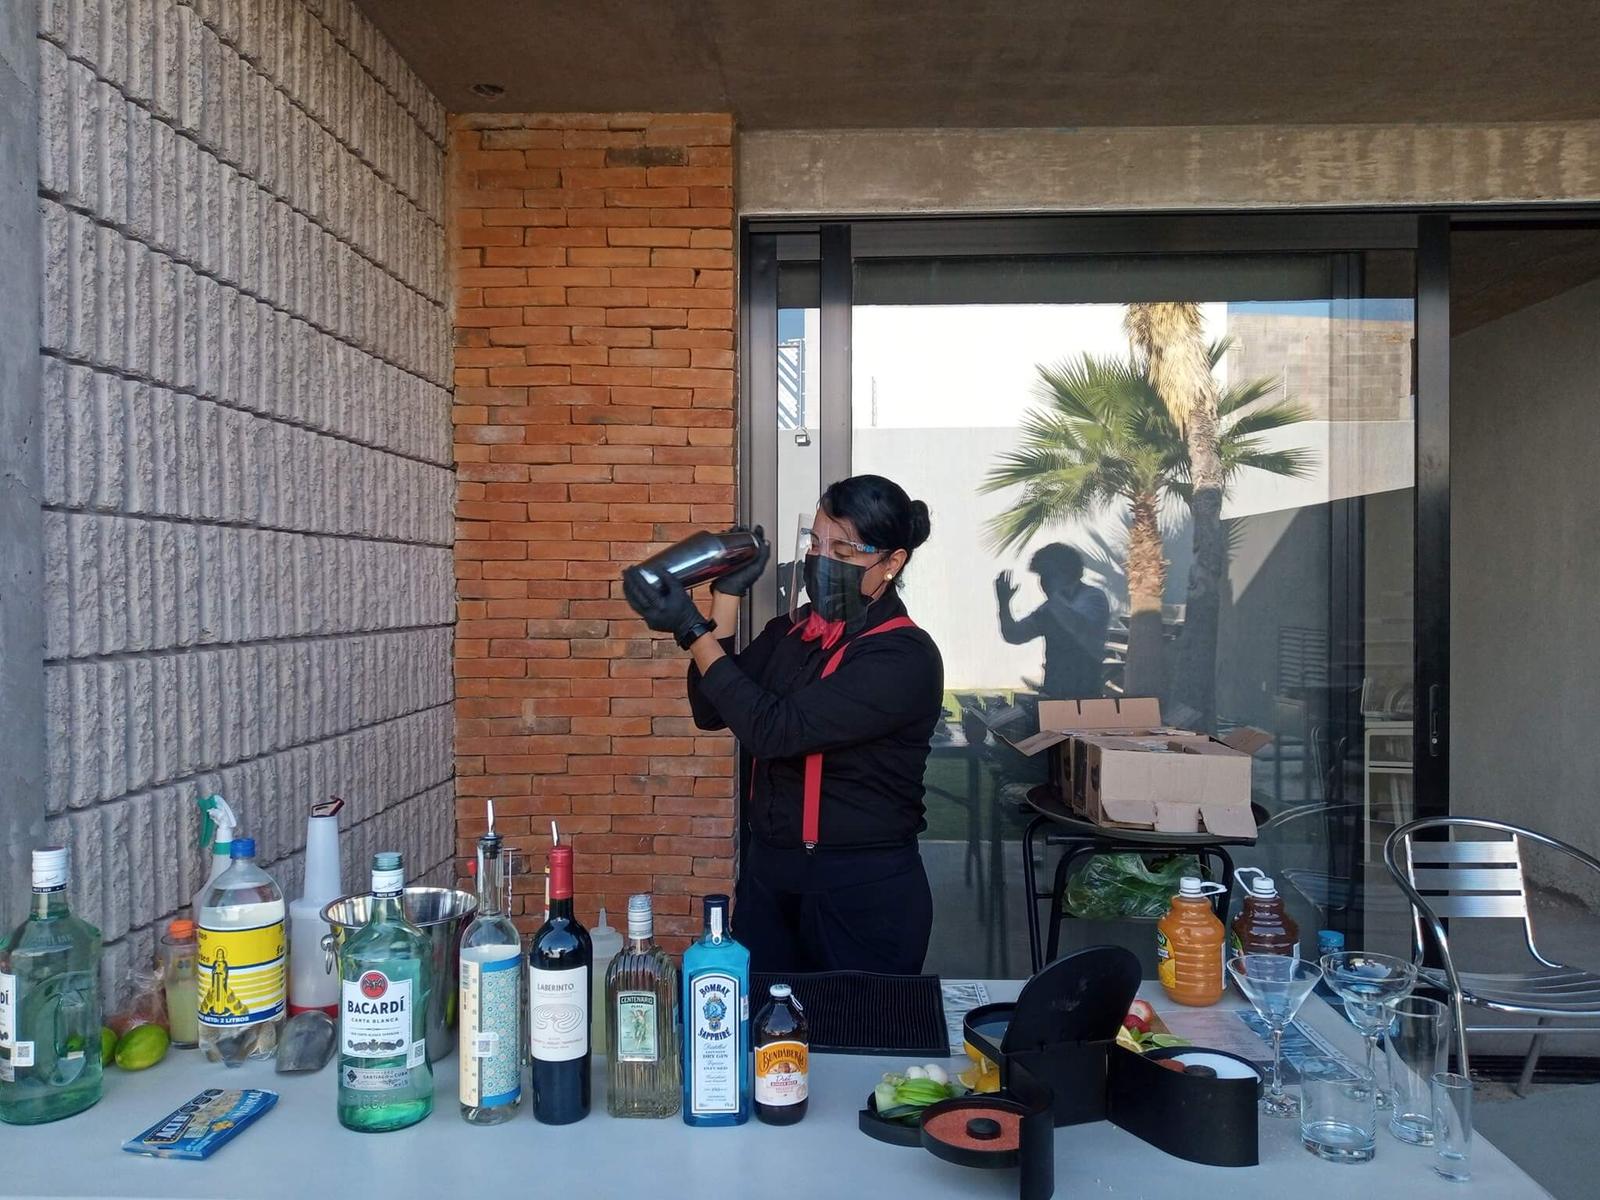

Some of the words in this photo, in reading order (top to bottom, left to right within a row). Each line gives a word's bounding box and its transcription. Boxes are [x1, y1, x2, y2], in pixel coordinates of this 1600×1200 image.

[537, 983, 574, 992] LABERINTO
[699, 983, 731, 998] BOMBAY
[347, 995, 405, 1015] BACARDÍ
[225, 1015, 250, 1024] LITROS
[372, 1016, 399, 1024] BLANCA
[698, 1026, 732, 1041] SAPPHIRE
